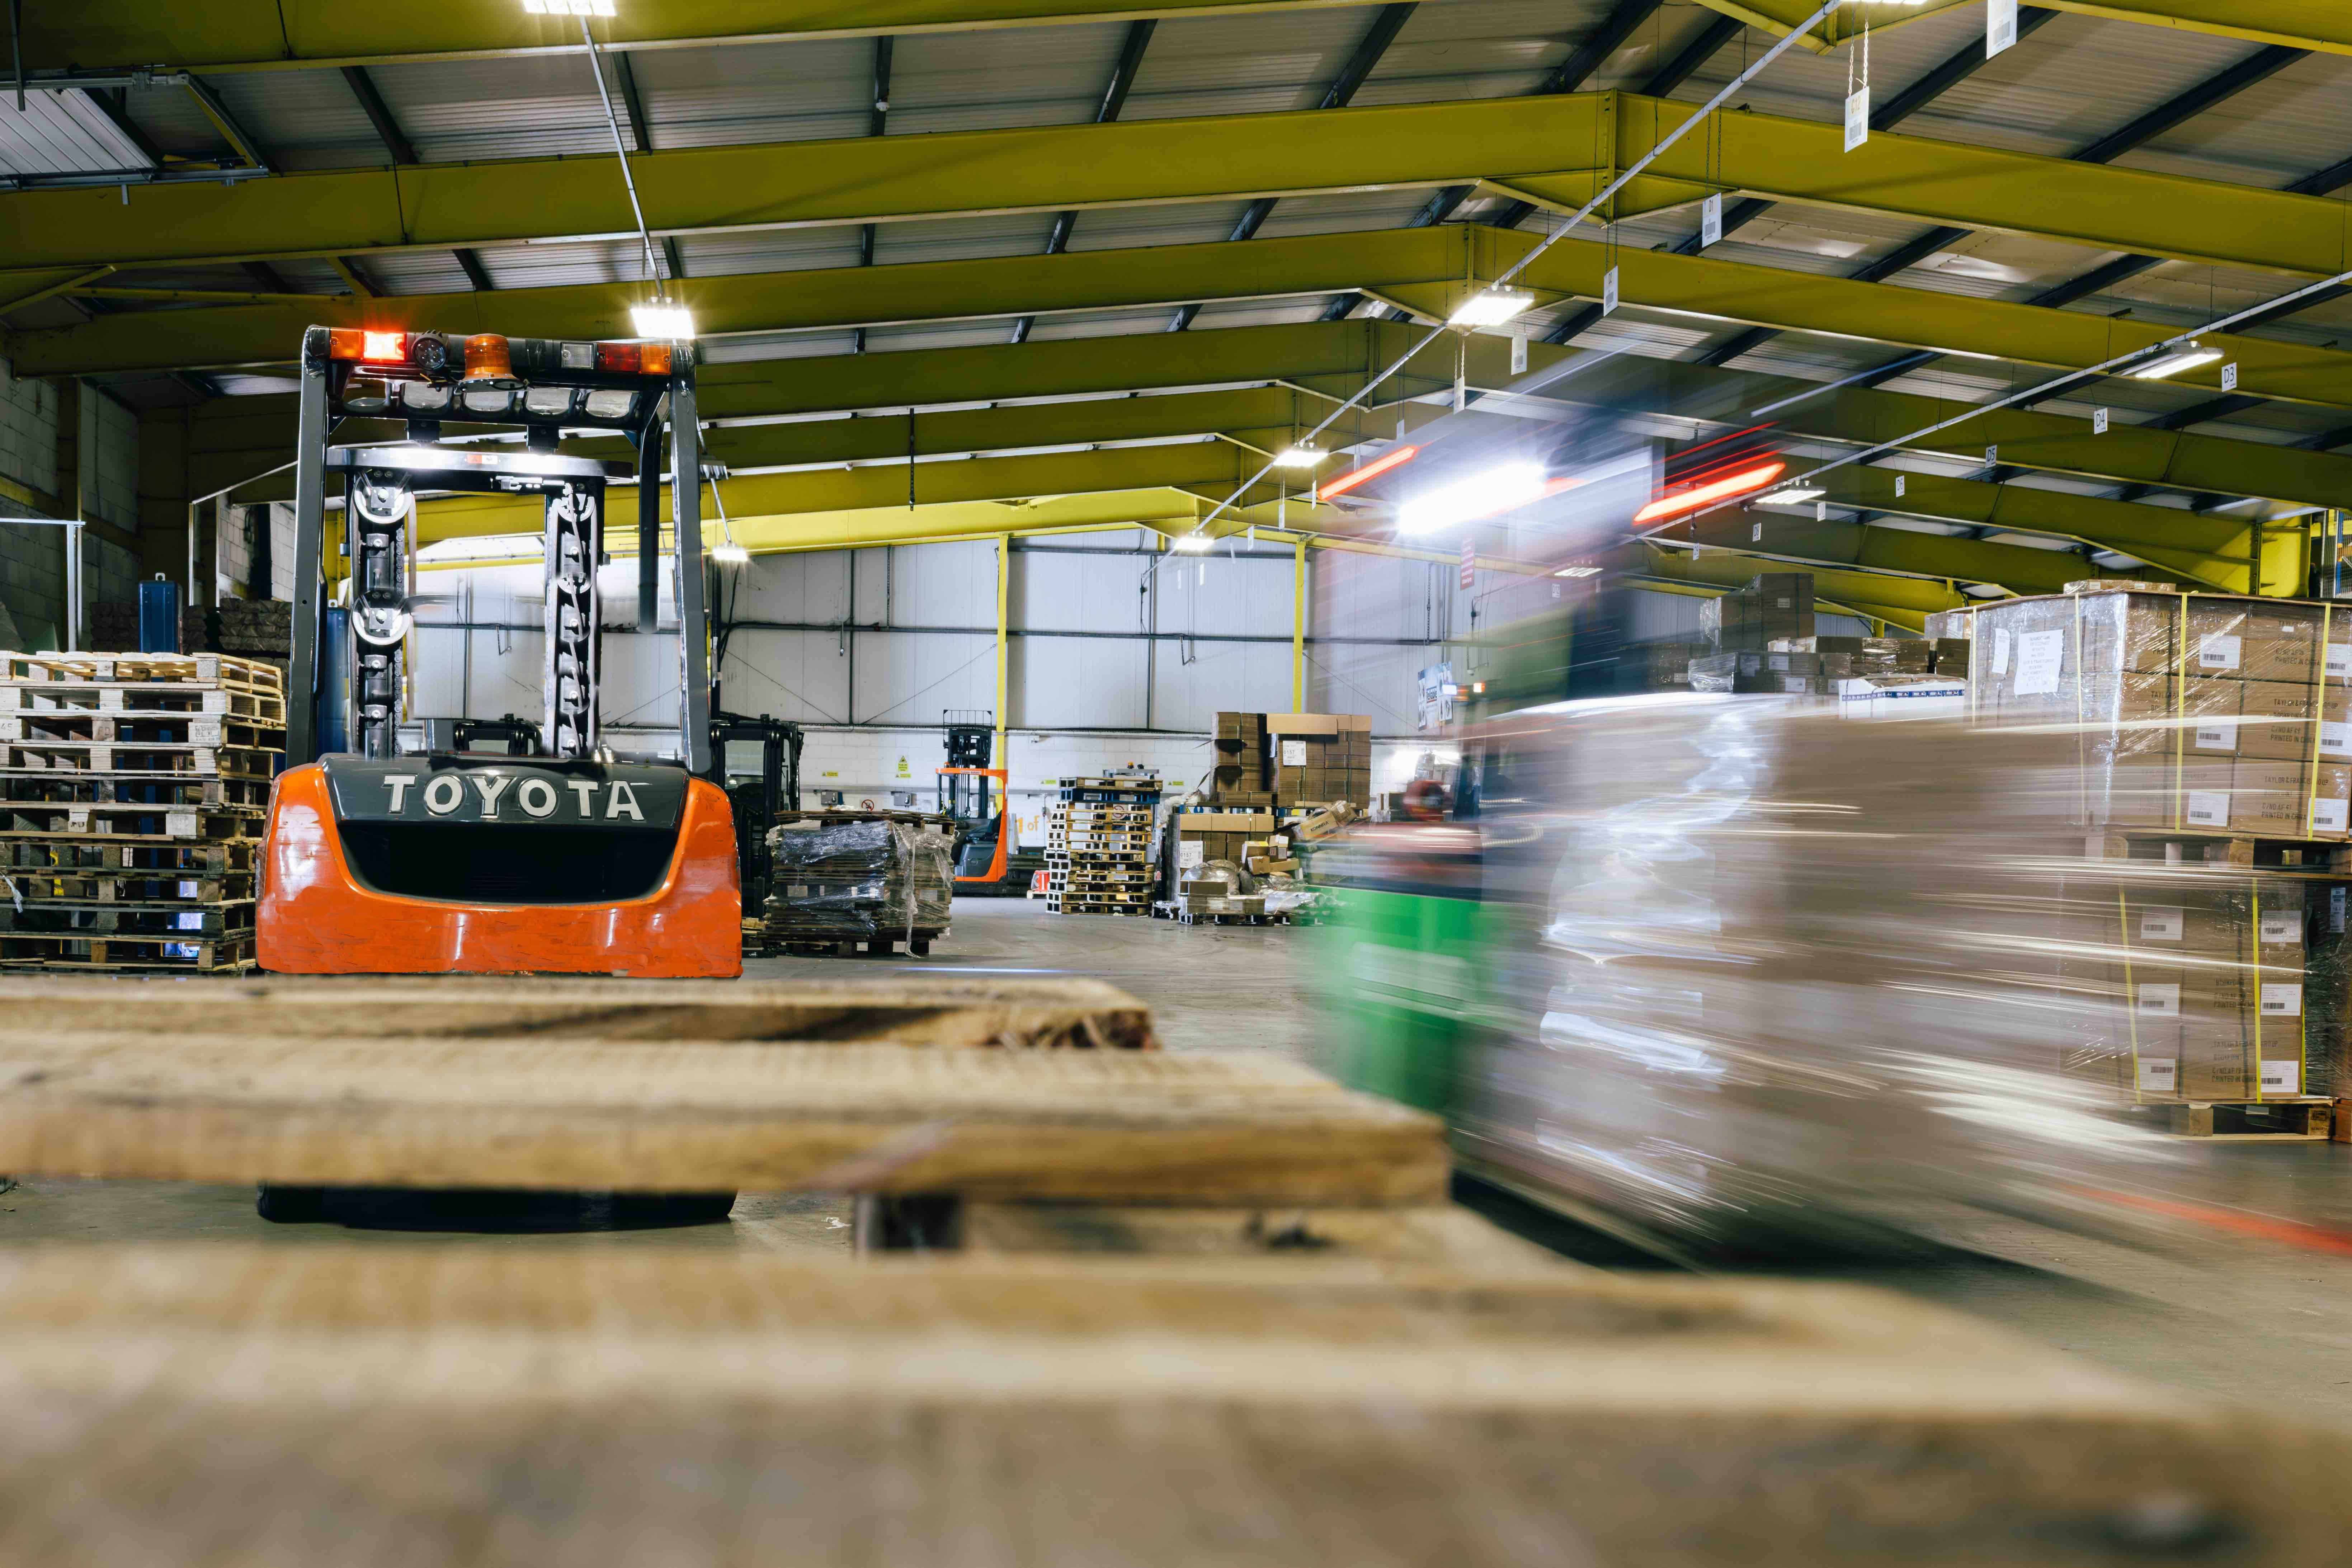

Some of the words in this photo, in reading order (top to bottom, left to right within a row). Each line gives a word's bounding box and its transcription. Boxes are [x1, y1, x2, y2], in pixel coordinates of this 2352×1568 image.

[2224, 366, 2234, 383] D3
[2096, 411, 2105, 427] D4
[1987, 448, 1995, 462] D5
[1897, 479, 1903, 491] D6
[382, 773, 645, 821] TOYOTA
[1027, 815, 1040, 832] of
